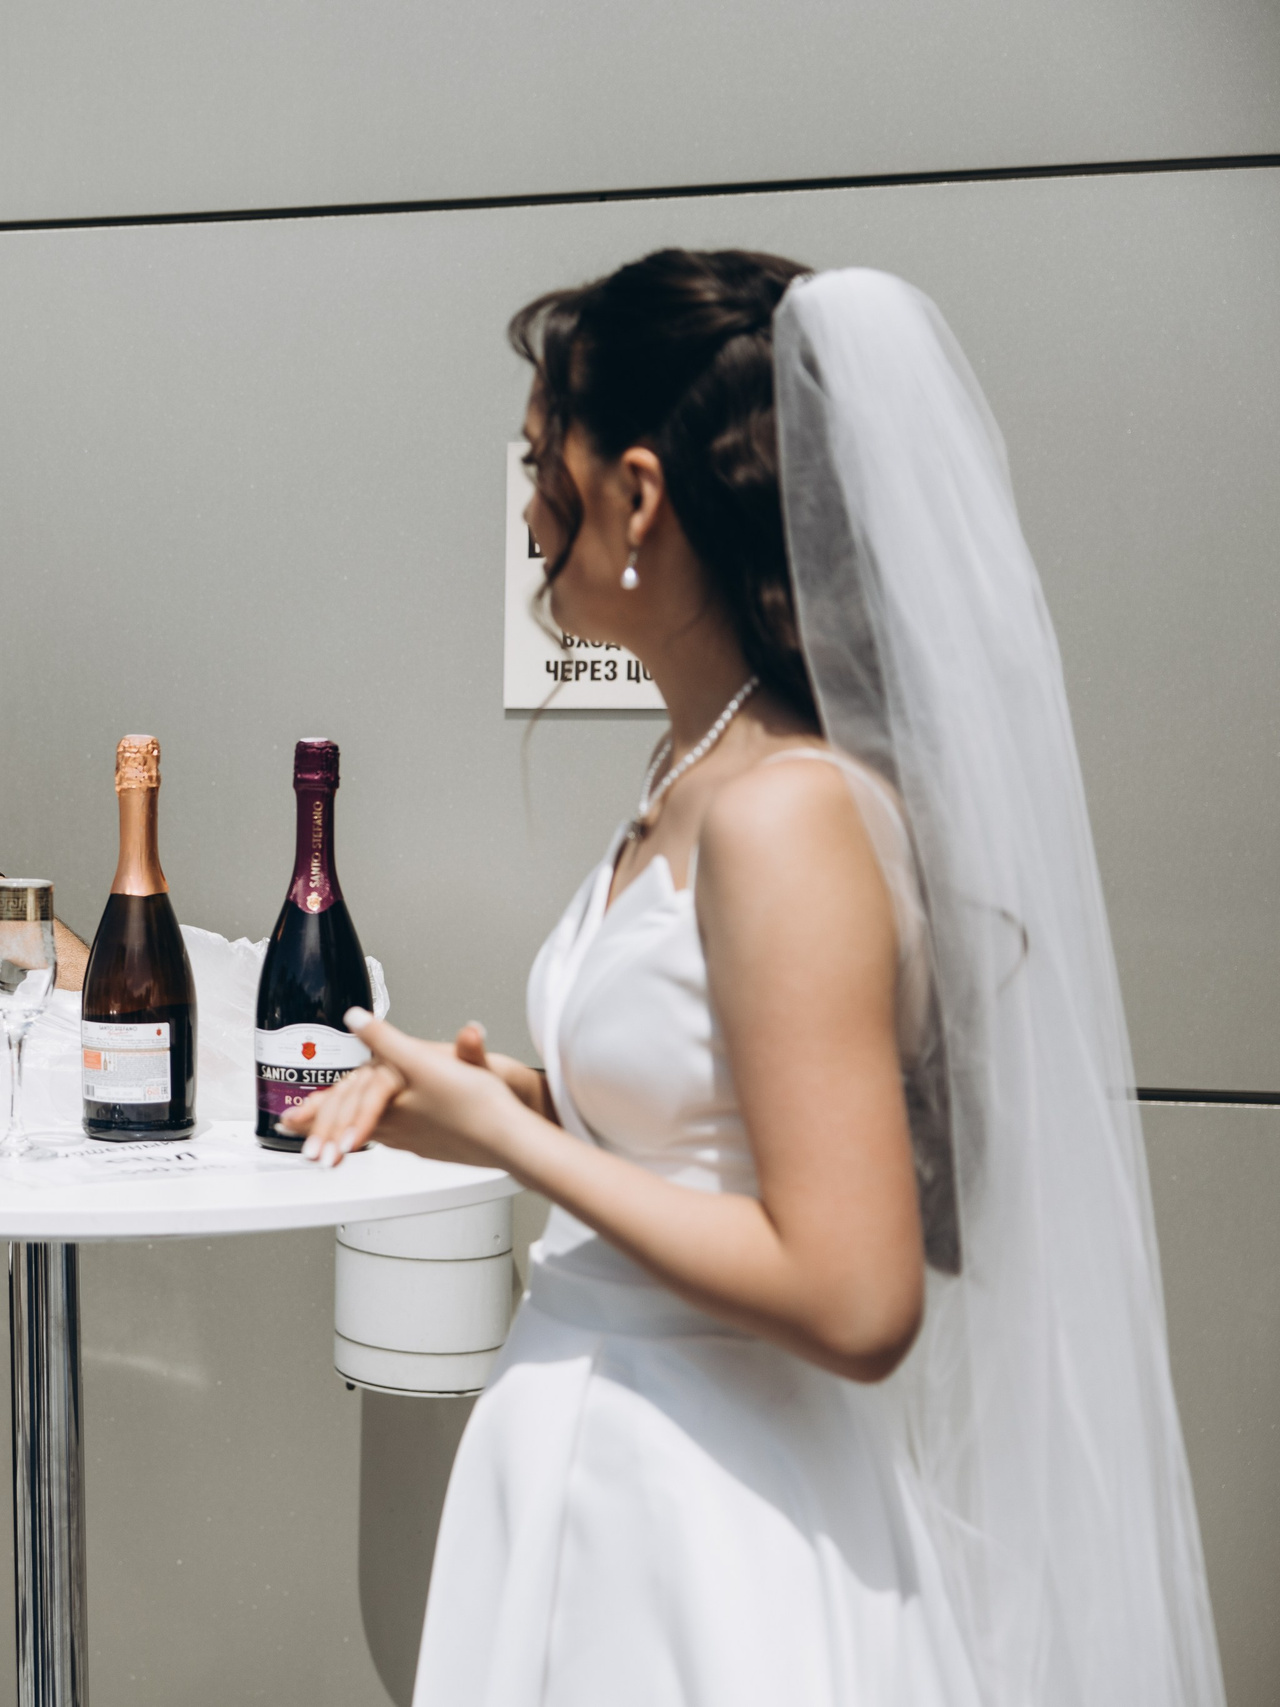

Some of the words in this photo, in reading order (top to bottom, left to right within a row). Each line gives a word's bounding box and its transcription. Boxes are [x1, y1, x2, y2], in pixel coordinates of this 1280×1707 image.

[545, 659, 618, 682] ЧЕРЕЗ
[311, 801, 324, 849] STEFANO
[308, 852, 322, 888] SANTO
[261, 1065, 299, 1082] SANTO
[302, 1069, 356, 1083] STEFA
[284, 1095, 306, 1106] RO
